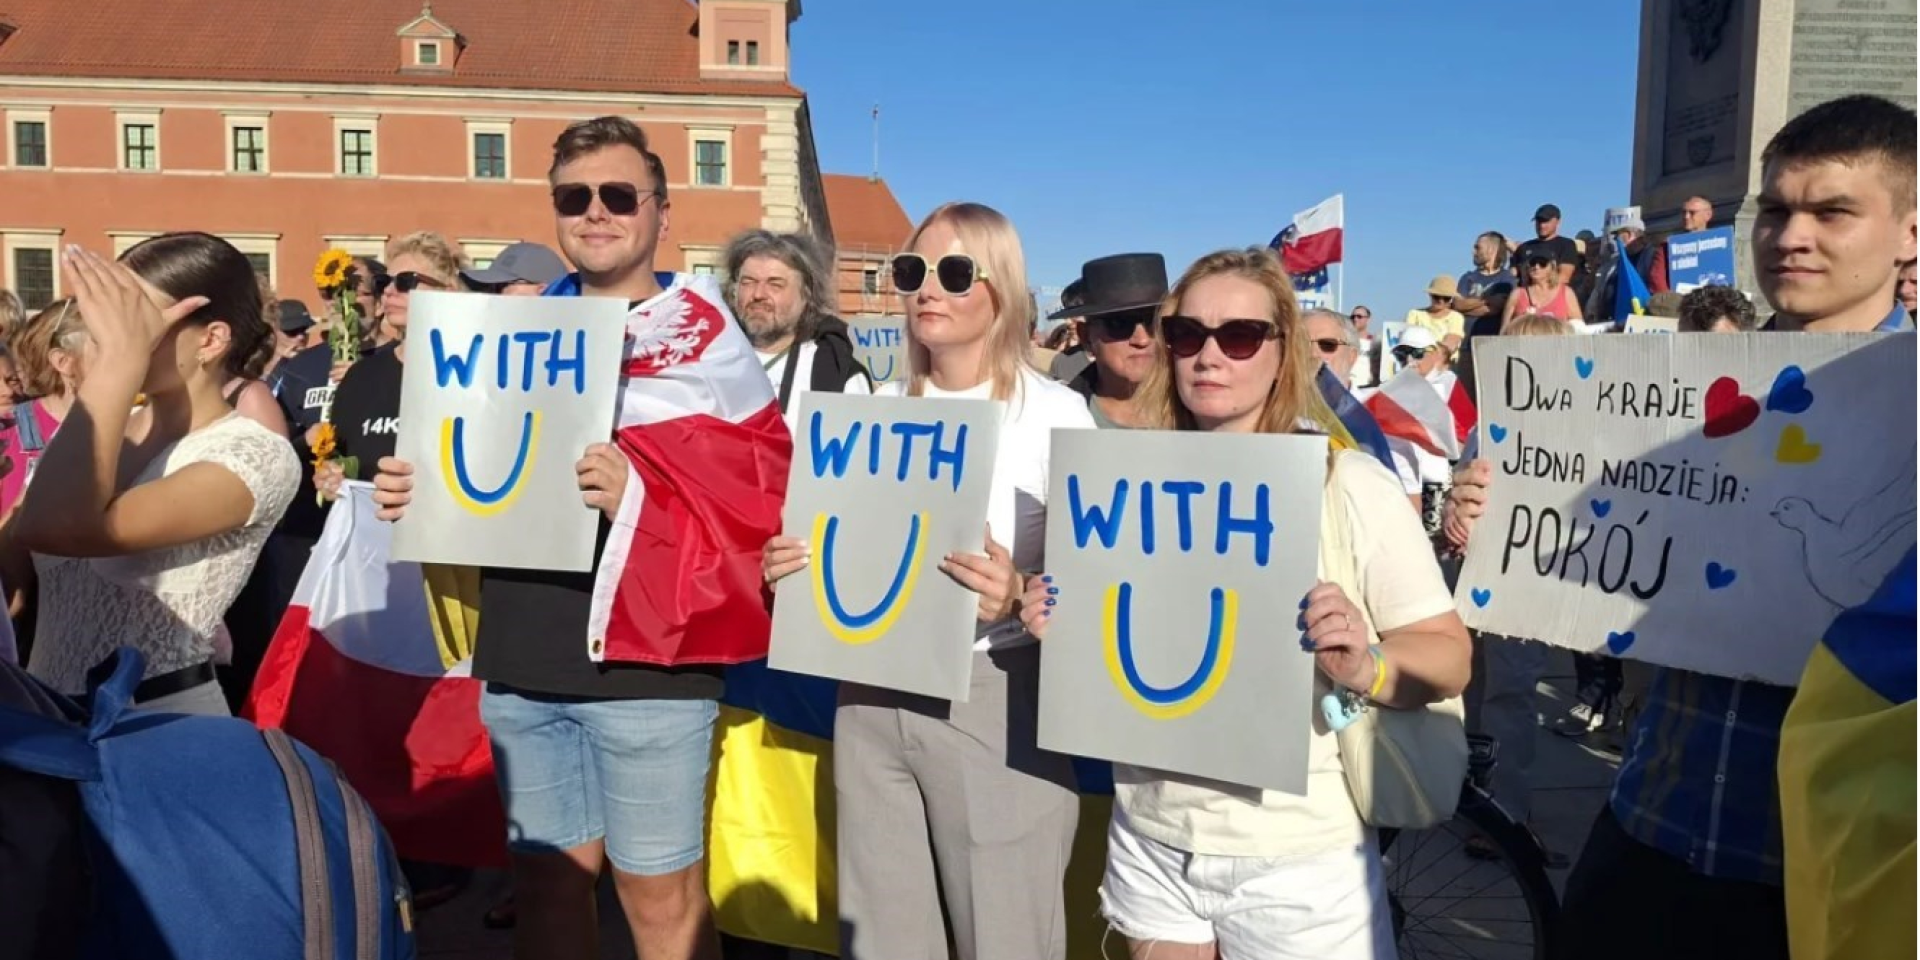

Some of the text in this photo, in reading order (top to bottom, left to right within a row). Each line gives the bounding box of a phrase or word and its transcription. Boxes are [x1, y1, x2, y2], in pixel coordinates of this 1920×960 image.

[429, 328, 587, 395] WITH
[440, 410, 543, 517] U
[810, 410, 969, 493] WITH
[1502, 430, 1587, 484] JEDNA
[1067, 474, 1274, 567] WITH
[1500, 503, 1674, 600] POKÓJ
[810, 510, 931, 645] U
[1103, 581, 1240, 720] U
